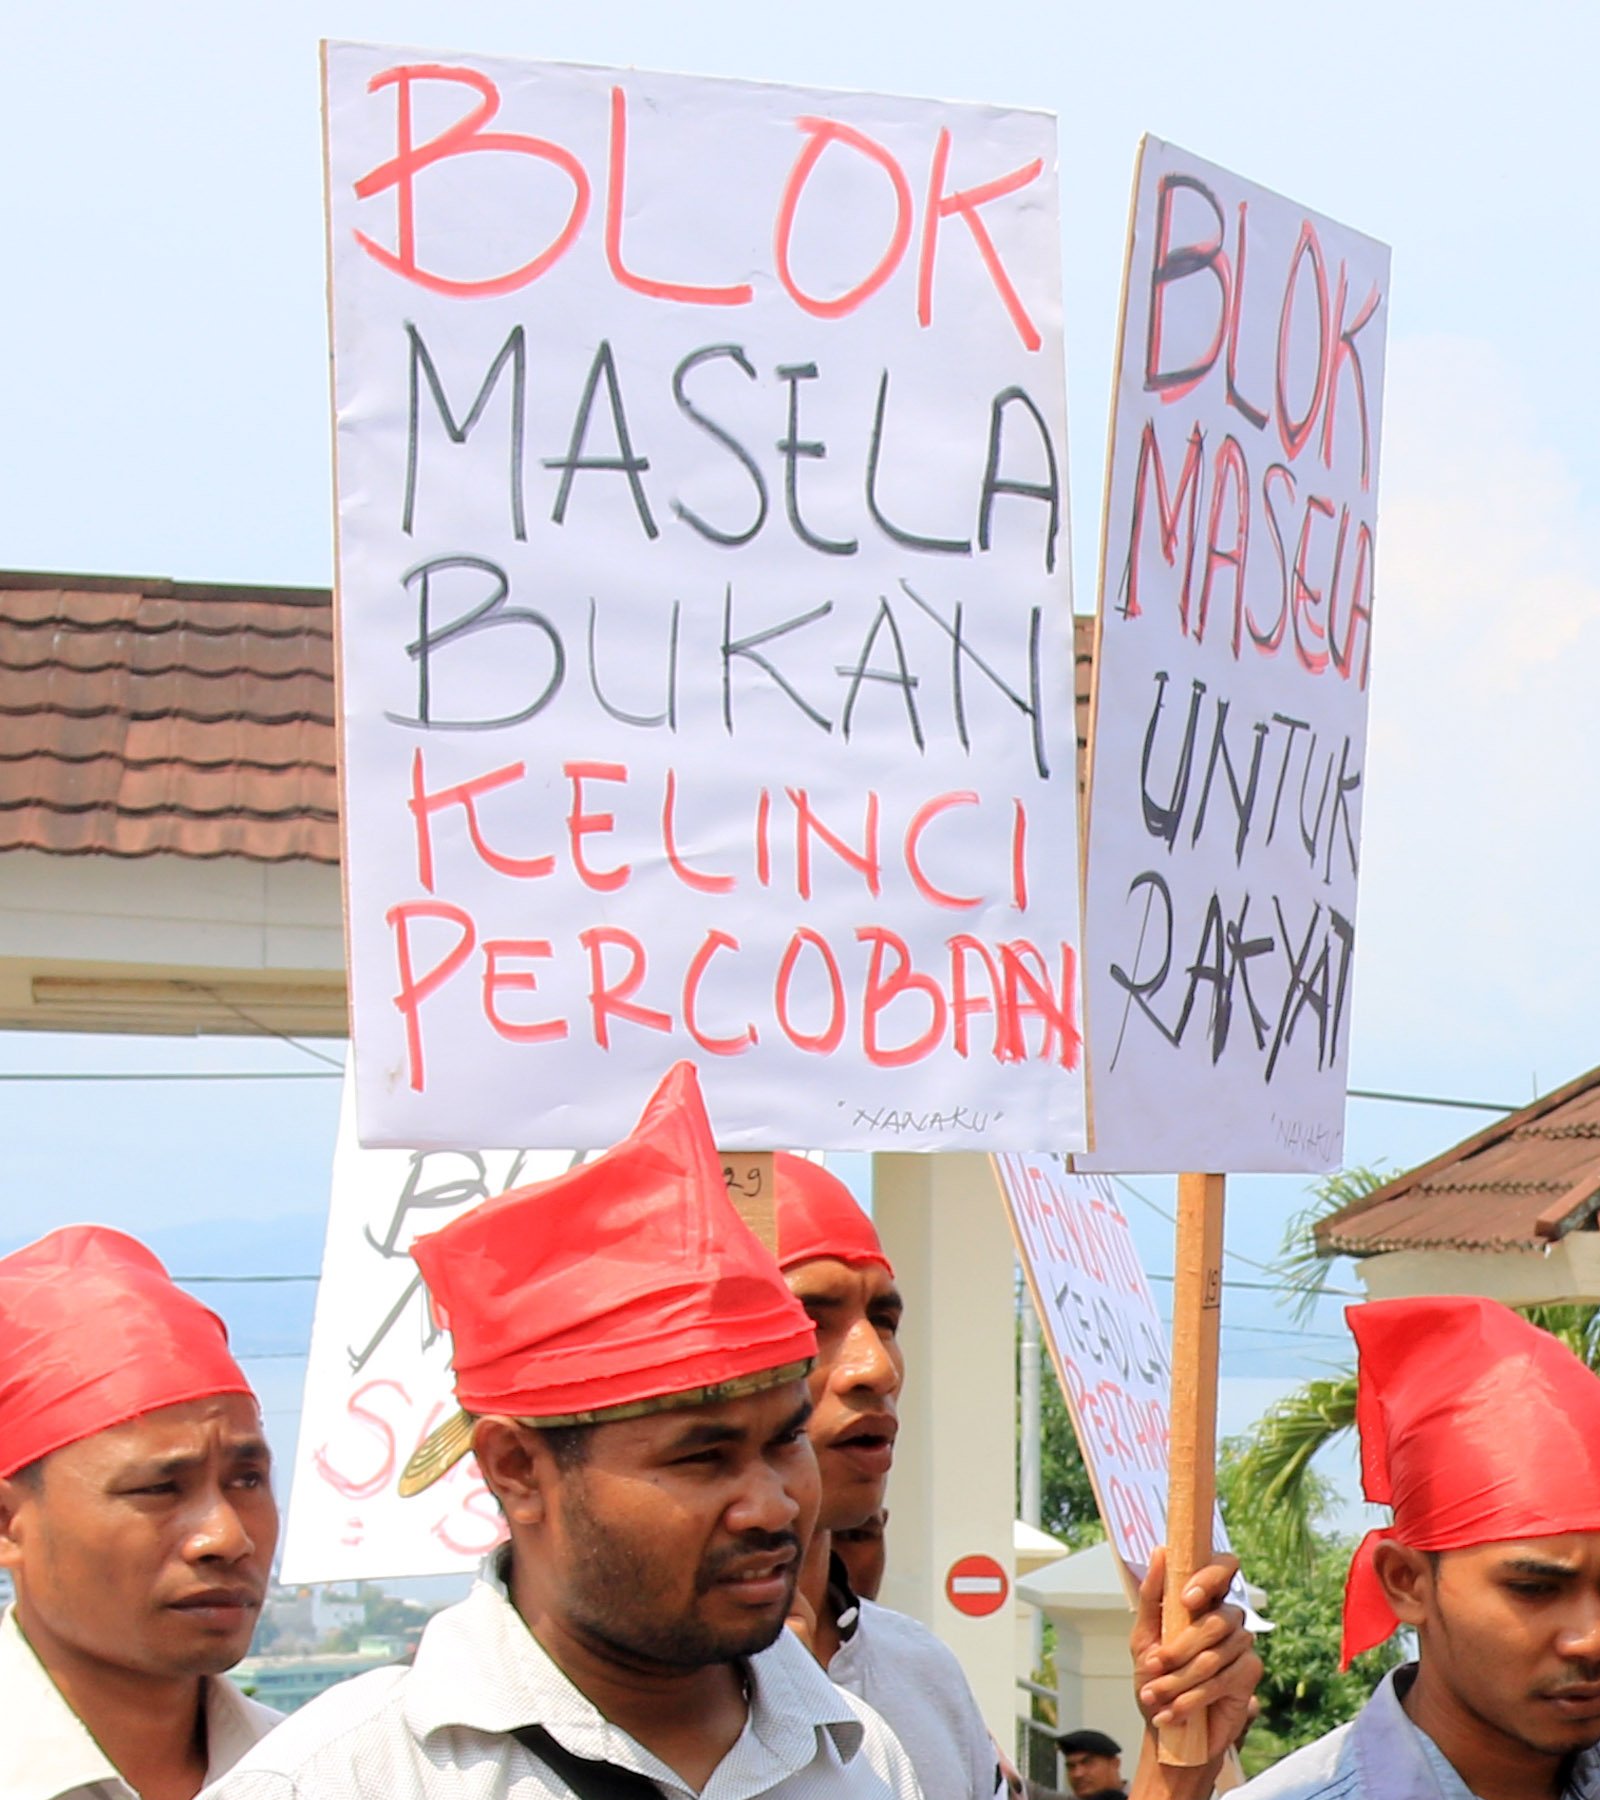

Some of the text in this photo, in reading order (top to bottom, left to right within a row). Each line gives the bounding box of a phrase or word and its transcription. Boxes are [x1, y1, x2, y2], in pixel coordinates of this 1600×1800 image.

[353, 64, 1041, 350] BLOK
[403, 320, 1060, 574] MASELA
[1143, 173, 1381, 494] BLOK
[386, 554, 1049, 779] BUKAN
[1115, 418, 1375, 692] MASELA
[410, 747, 1029, 912] KELINCI
[1142, 671, 1361, 885] UNTUK
[1109, 870, 1354, 1084] RAKYAT
